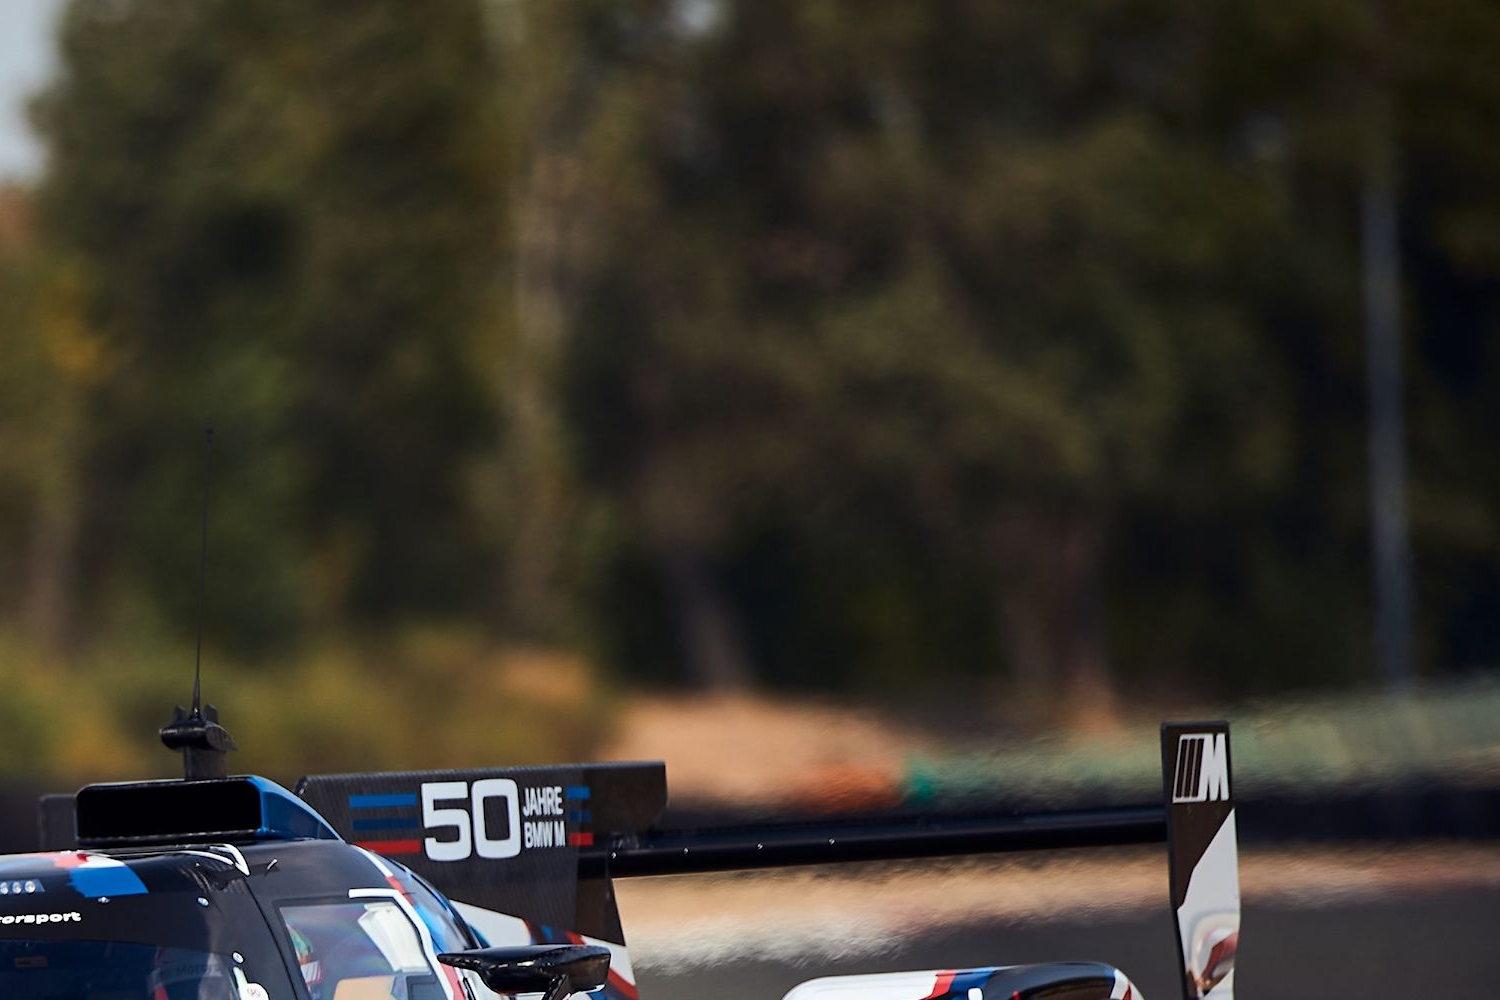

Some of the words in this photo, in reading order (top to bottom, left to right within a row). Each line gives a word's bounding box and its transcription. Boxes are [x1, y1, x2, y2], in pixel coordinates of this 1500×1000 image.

[1172, 732, 1230, 804] M
[421, 778, 522, 862] 50
[522, 785, 565, 817] JAHRE
[524, 821, 552, 849] BMW
[553, 820, 566, 847] M
